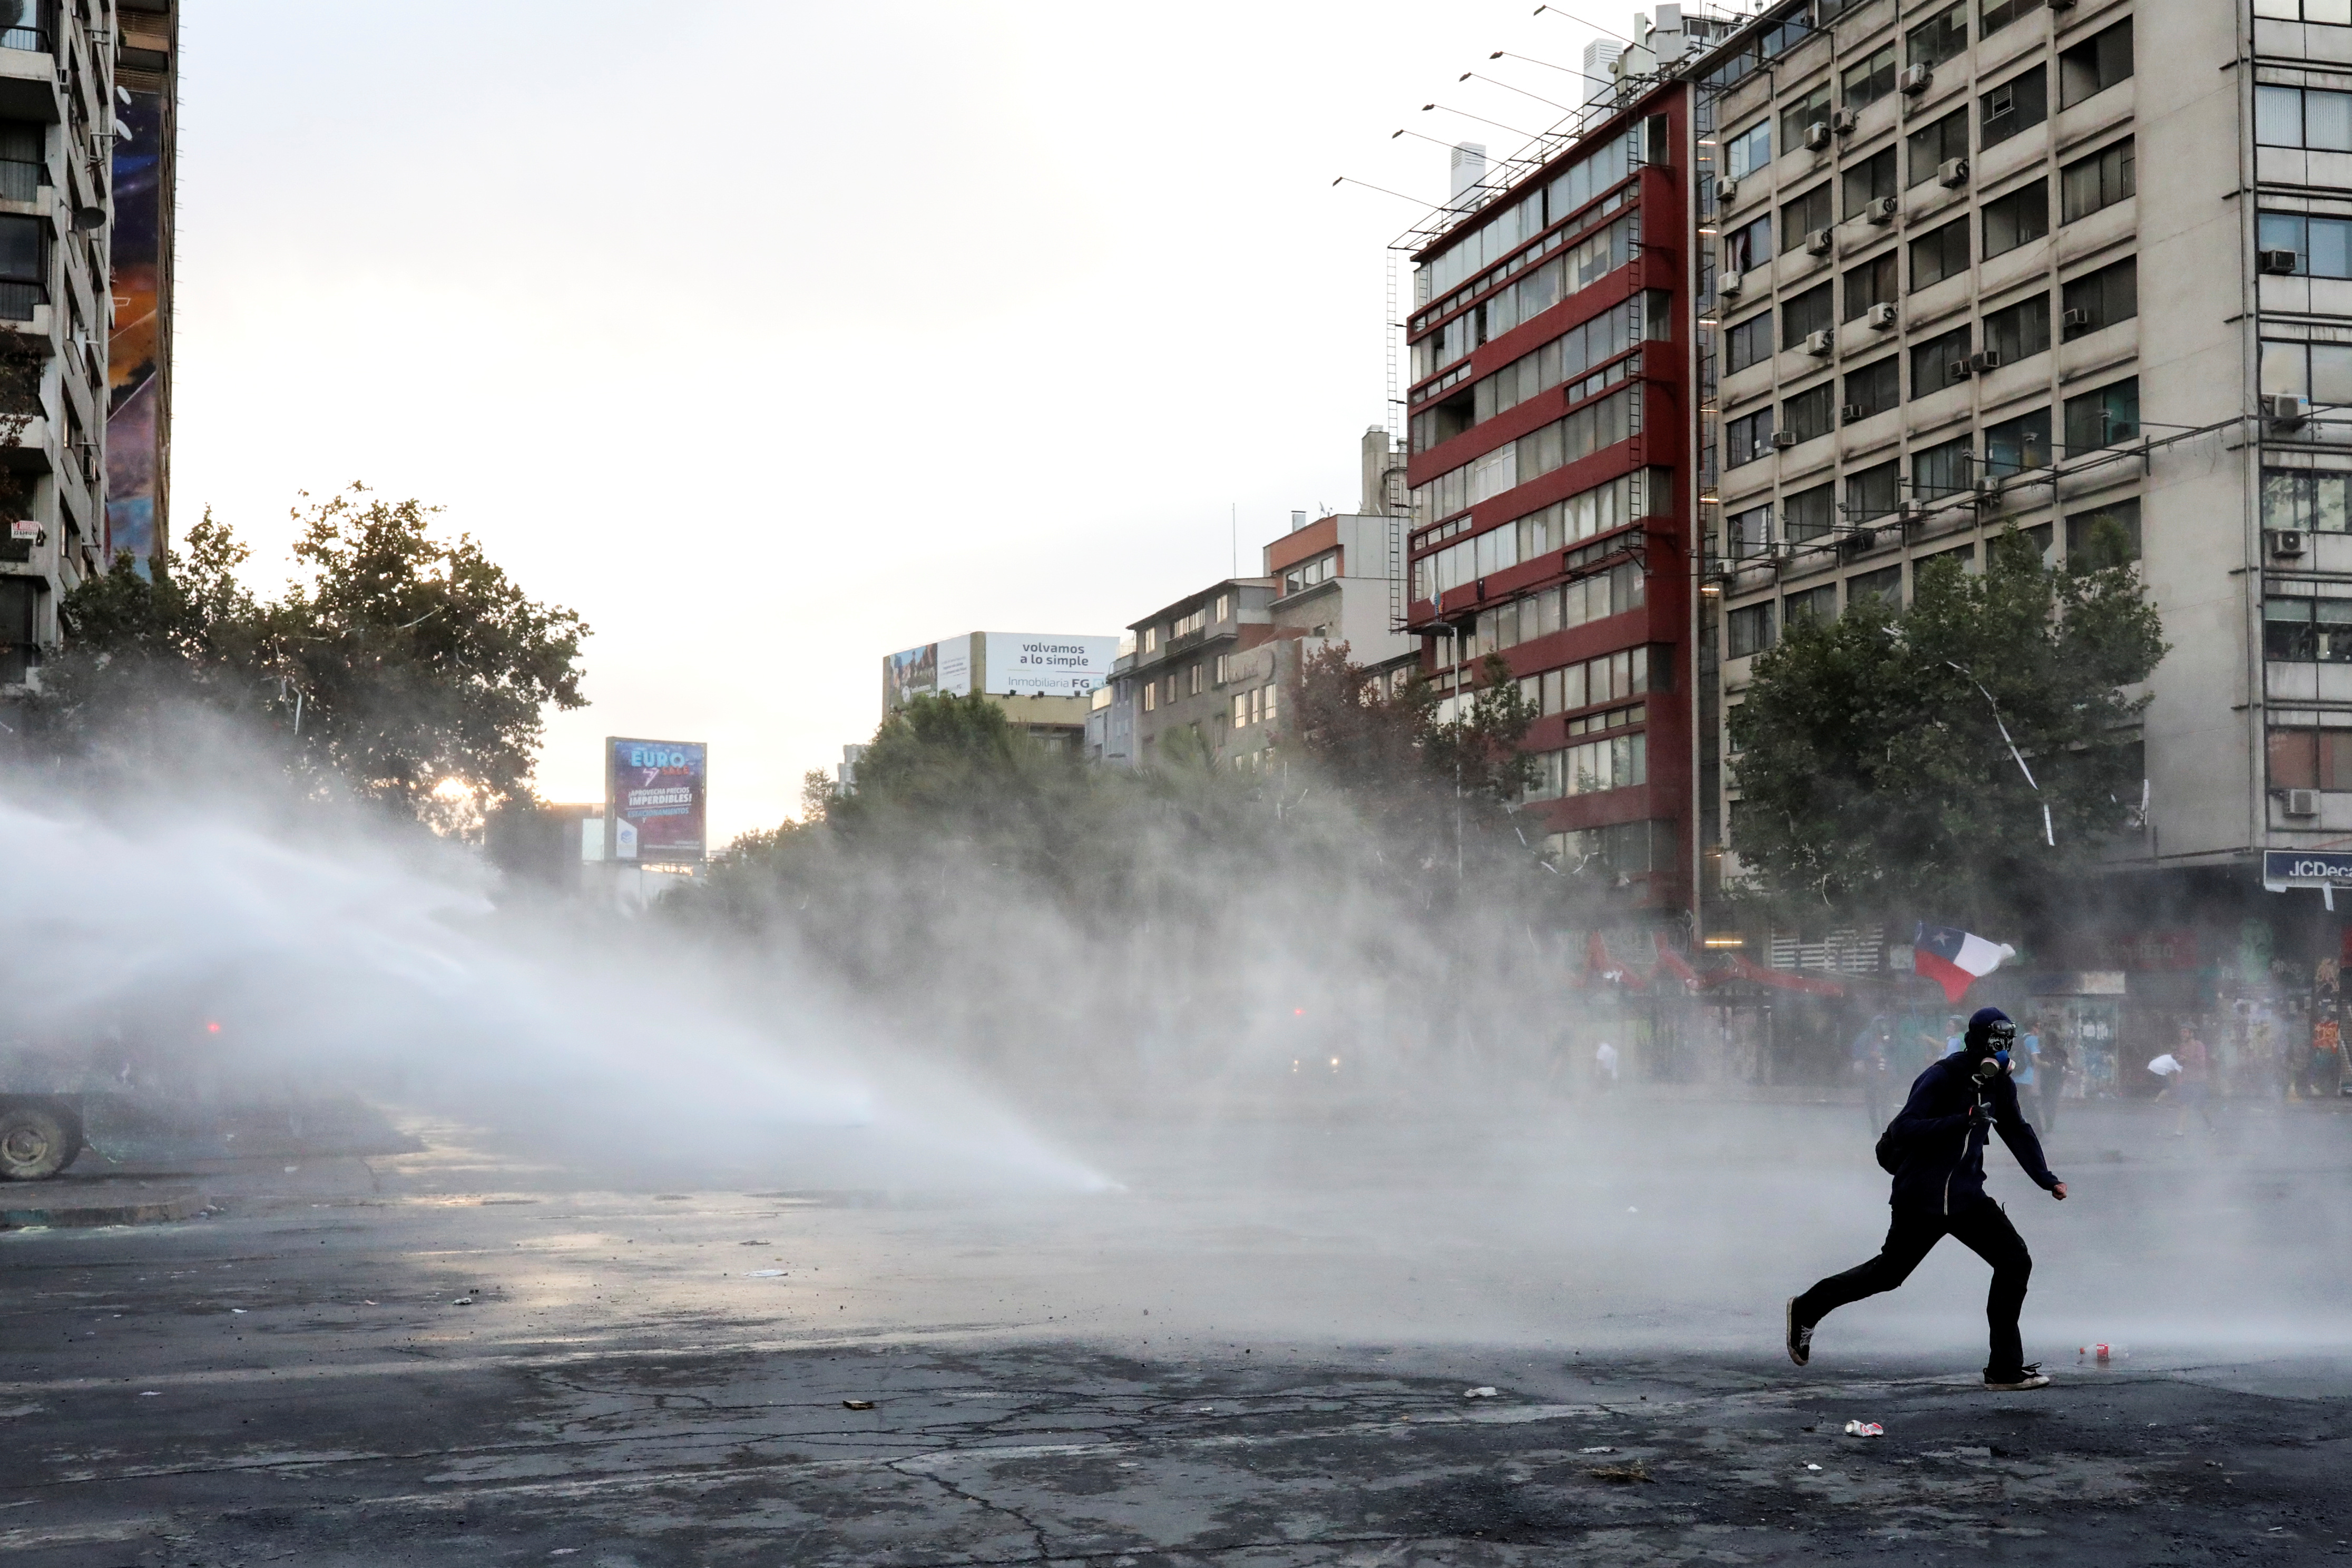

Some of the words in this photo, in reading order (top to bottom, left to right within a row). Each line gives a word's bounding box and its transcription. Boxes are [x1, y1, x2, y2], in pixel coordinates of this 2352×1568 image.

[1023, 642, 1085, 654] volvamos
[1020, 655, 1027, 664] a
[1031, 654, 1043, 664] lo
[1046, 655, 1089, 668] simple
[1008, 677, 1069, 688] Inmobiliaria
[1072, 679, 1090, 688] FG
[631, 750, 685, 768] EURO
[629, 793, 692, 806] IMPERDIBLES!
